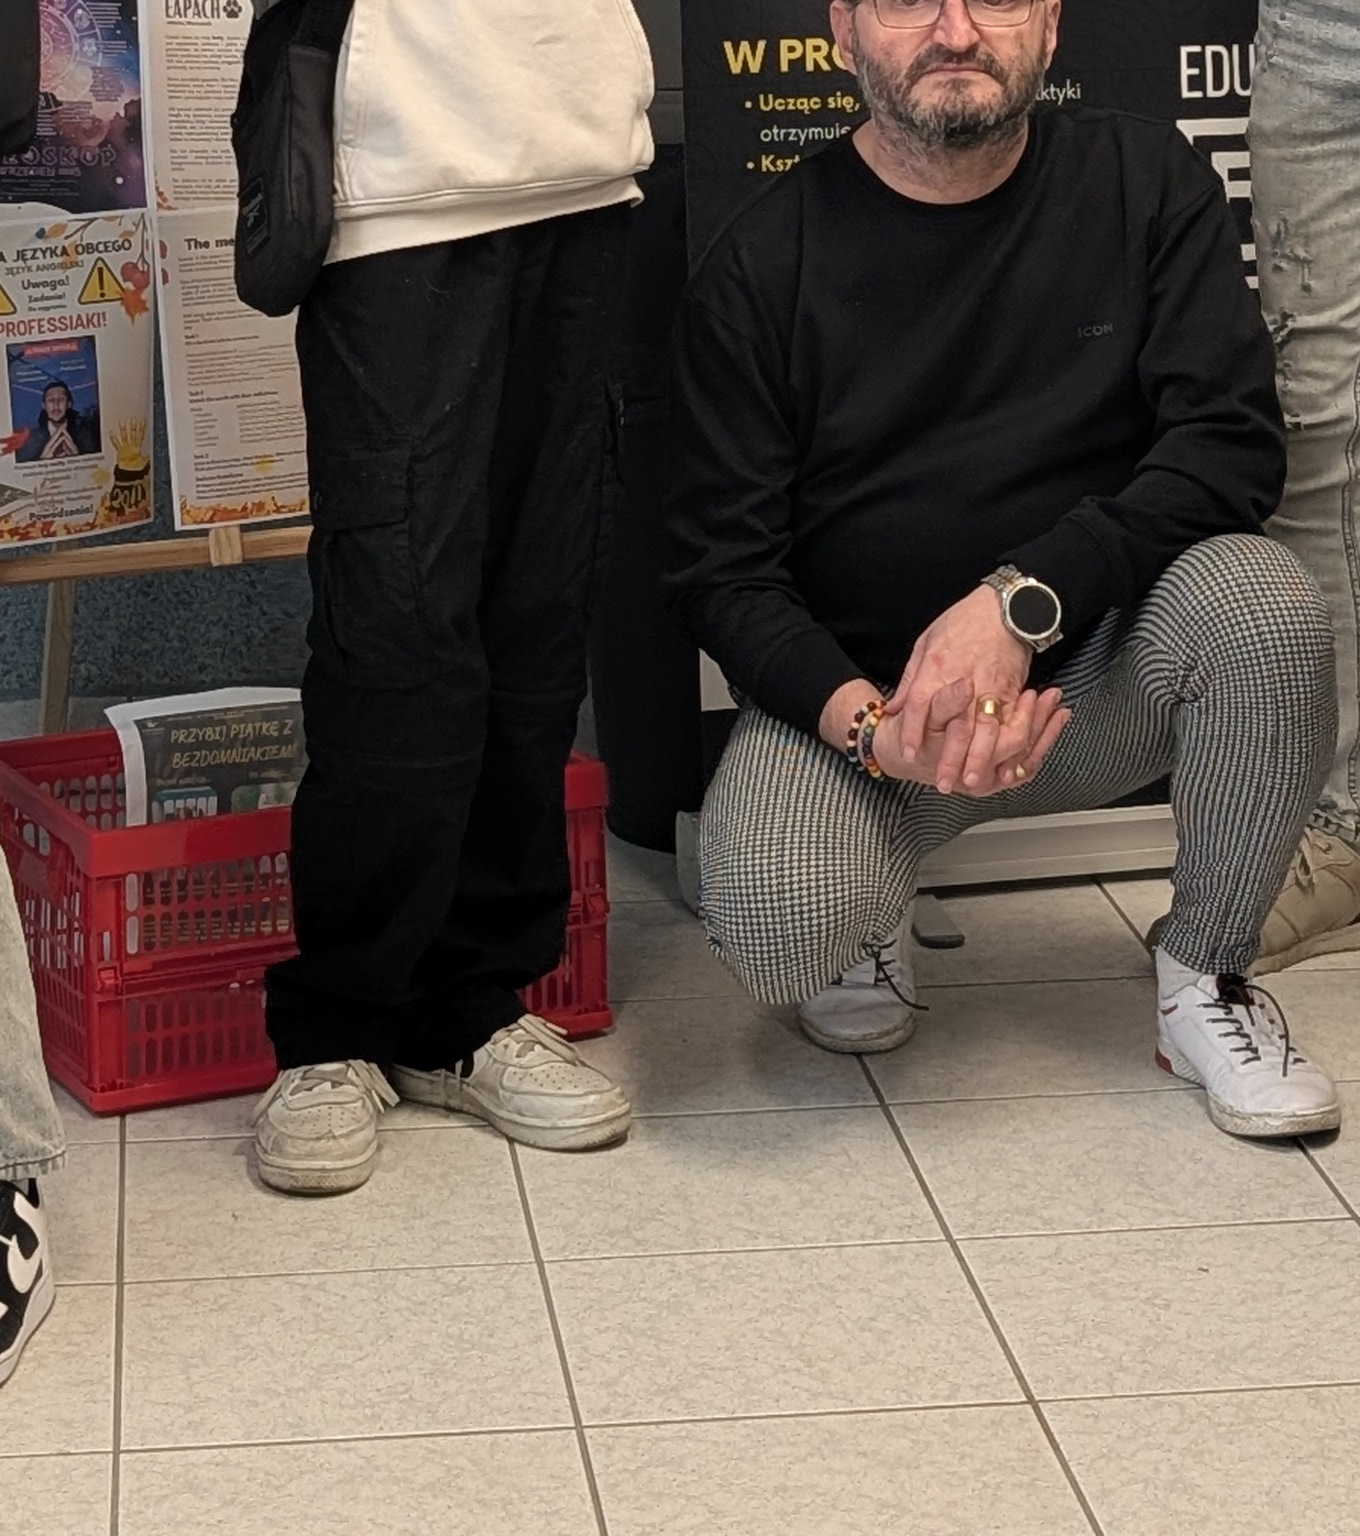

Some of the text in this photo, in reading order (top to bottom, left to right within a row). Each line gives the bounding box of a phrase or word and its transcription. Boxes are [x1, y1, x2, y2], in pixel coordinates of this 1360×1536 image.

[723, 39, 767, 74] W
[759, 91, 861, 114] Ucząc się,
[12, 244, 70, 265] JĘZYKA
[74, 238, 133, 256] OBCEGO
[184, 237, 210, 251] The
[21, 275, 70, 291] Uwaga!
[1077, 323, 1114, 338] ICON
[170, 725, 227, 744] PRZYBIJ
[283, 719, 294, 735] Z
